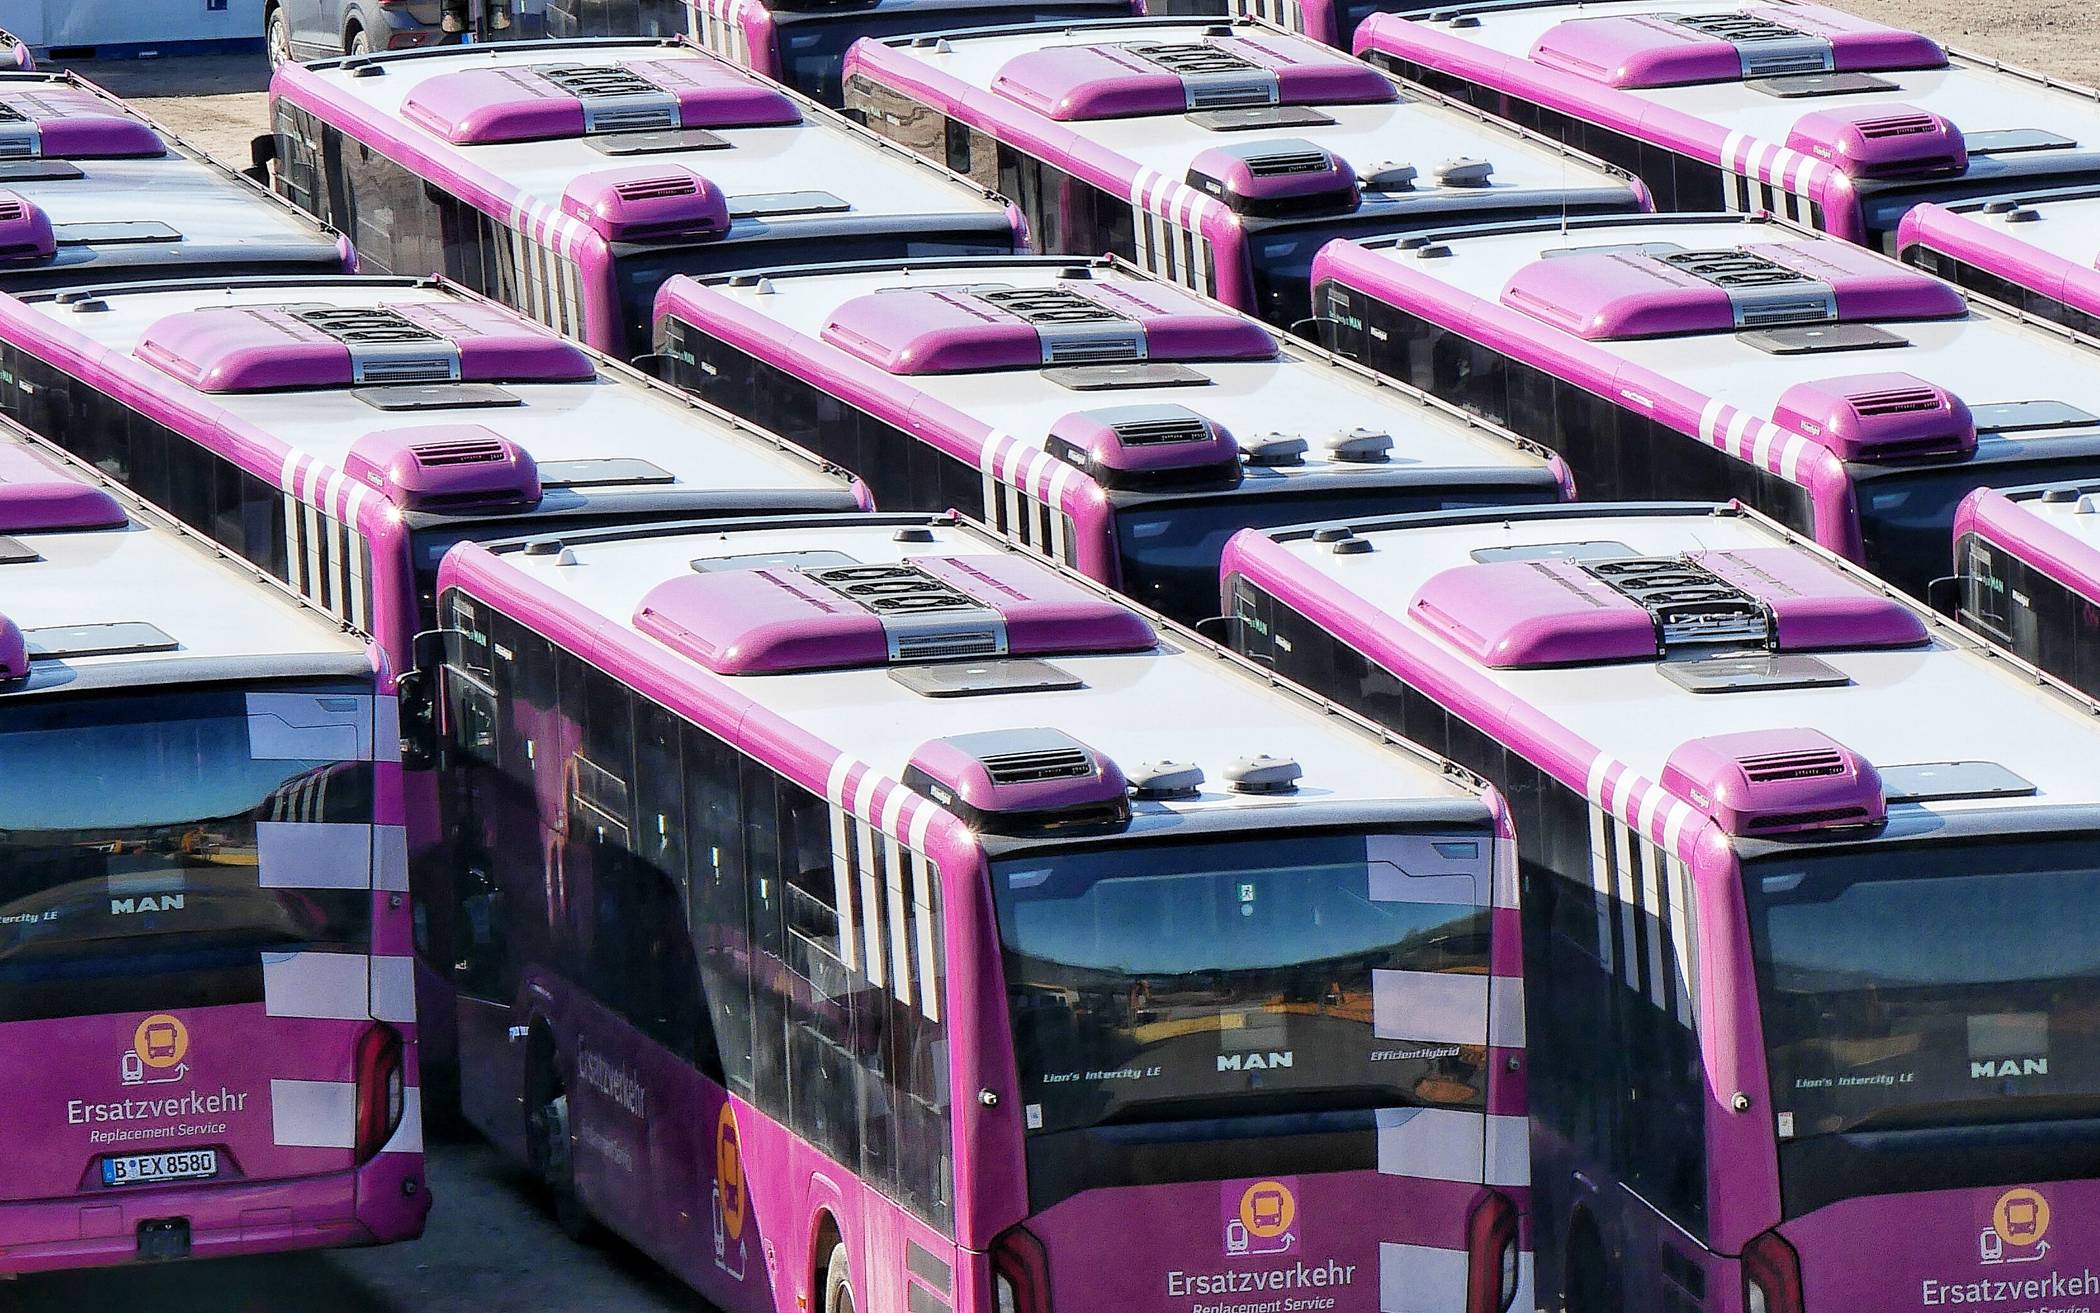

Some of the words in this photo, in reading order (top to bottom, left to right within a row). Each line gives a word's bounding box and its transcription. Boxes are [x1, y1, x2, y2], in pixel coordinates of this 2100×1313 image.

[111, 894, 184, 915] MAN
[43, 911, 58, 921] LE
[1217, 1051, 1293, 1071] MAN
[1971, 1058, 2048, 1078] MAN
[1043, 1072, 1080, 1083] Lion's
[1085, 1068, 1142, 1080] Intercity
[1146, 1066, 1162, 1077] LE
[1795, 1078, 1833, 1088] Lion's
[1838, 1074, 1894, 1085] Intercity
[68, 1086, 247, 1124] Ersatzverkehr
[90, 1125, 175, 1144] Replacement
[178, 1122, 226, 1136] Service
[115, 1161, 126, 1178] B
[1168, 1259, 1356, 1296] Ersatzverkehr
[1284, 1296, 1335, 1311] Service
